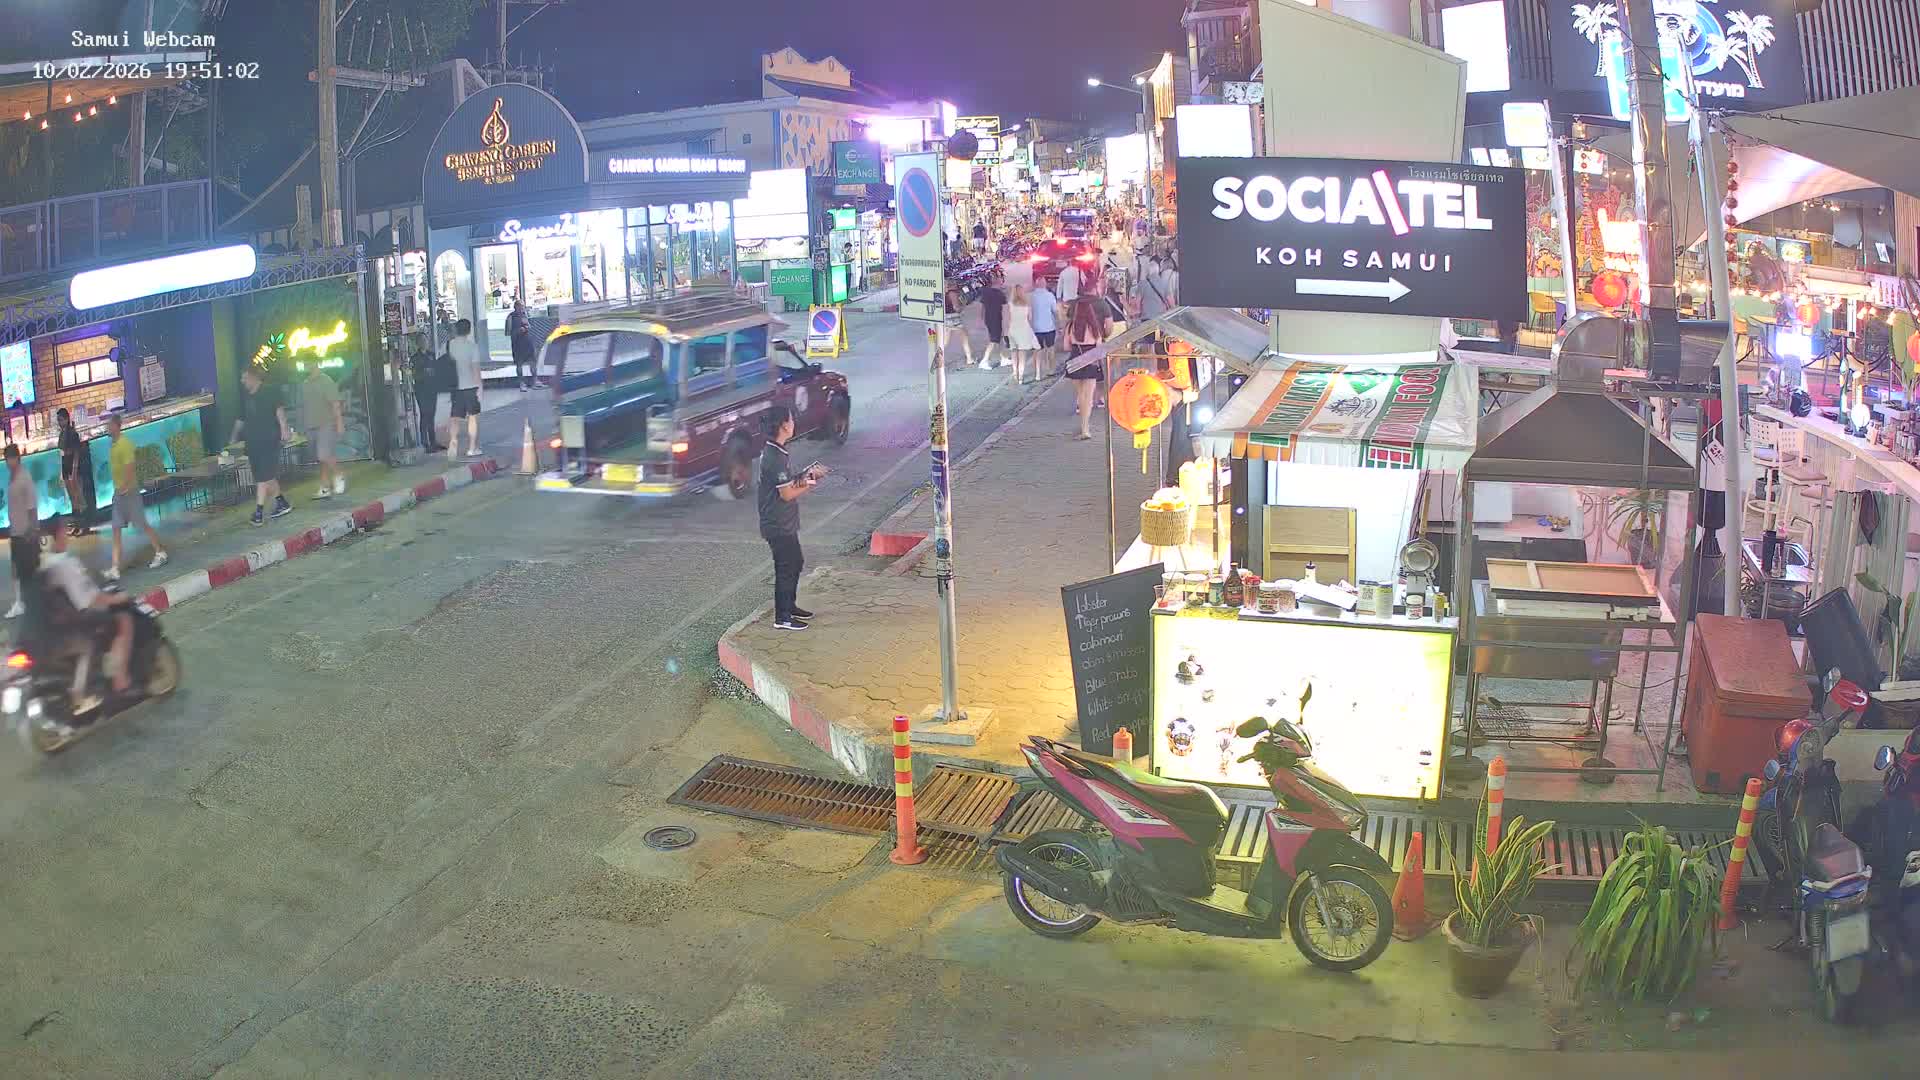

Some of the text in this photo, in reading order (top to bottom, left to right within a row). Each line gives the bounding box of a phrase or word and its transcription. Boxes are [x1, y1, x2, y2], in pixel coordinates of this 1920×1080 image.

[504, 140, 556, 160] GARDEN
[837, 168, 878, 179] EXCHANGE
[1255, 247, 1451, 272] KOH SAMUI
[771, 274, 810, 284] EXCHANGE
[905, 278, 937, 288] NO PARKING
[1091, 722, 1112, 745] Red
